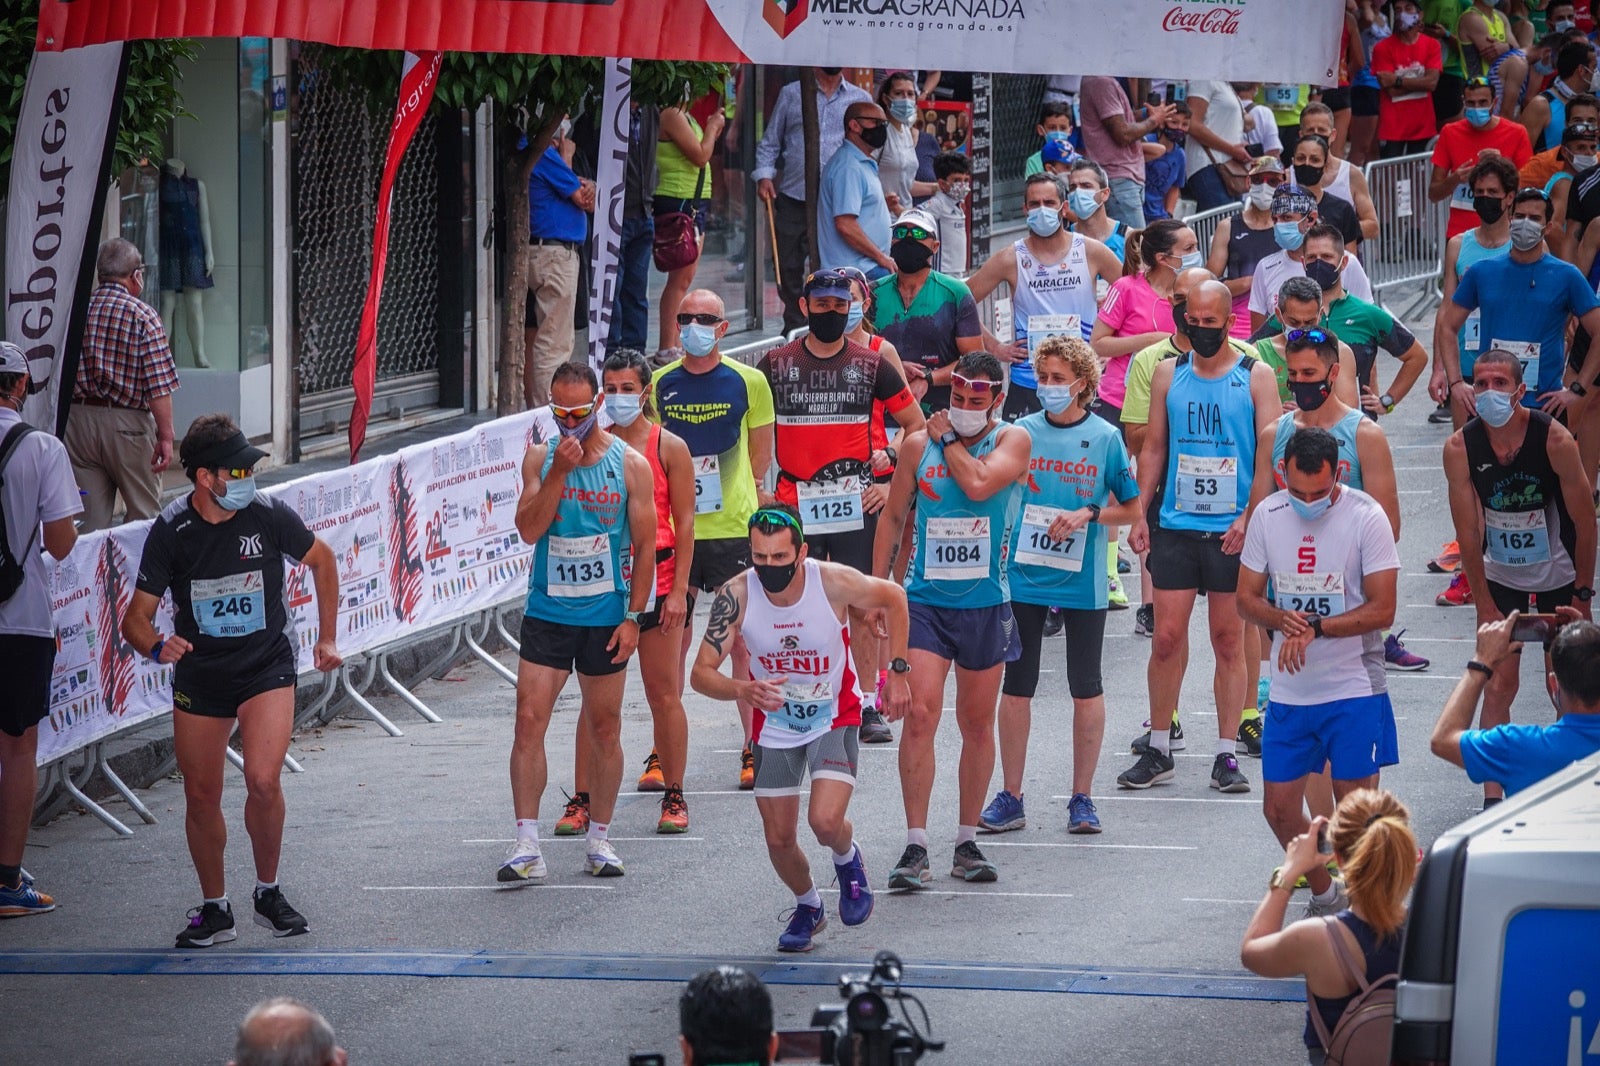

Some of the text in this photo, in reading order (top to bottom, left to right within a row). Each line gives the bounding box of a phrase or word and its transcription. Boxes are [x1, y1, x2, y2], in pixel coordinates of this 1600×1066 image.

[811, 0, 1025, 19] MERCAGRANADA
[822, 18, 1013, 32] www.mercagranada.es
[1277, 89, 1292, 100] 55
[1028, 276, 1082, 289] MARACENA
[828, 391, 855, 403] BLANCA
[664, 402, 732, 413] ATLETISMO
[1187, 401, 1222, 435] ENA
[467, 470, 478, 481] DE
[479, 461, 516, 478] GRANADA
[560, 485, 621, 505] tracón
[1194, 478, 1218, 496] 53
[810, 501, 853, 519] 1125
[1195, 503, 1212, 512] JORGE
[1499, 532, 1536, 549] 162
[936, 544, 981, 563] 1084
[556, 560, 605, 582] 1133
[211, 597, 253, 618] 246
[1291, 597, 1331, 617] 245
[220, 625, 246, 634] ANTONIO
[766, 649, 818, 658] ALICATADOS
[758, 656, 829, 676] BENJI
[782, 701, 819, 720] 136
